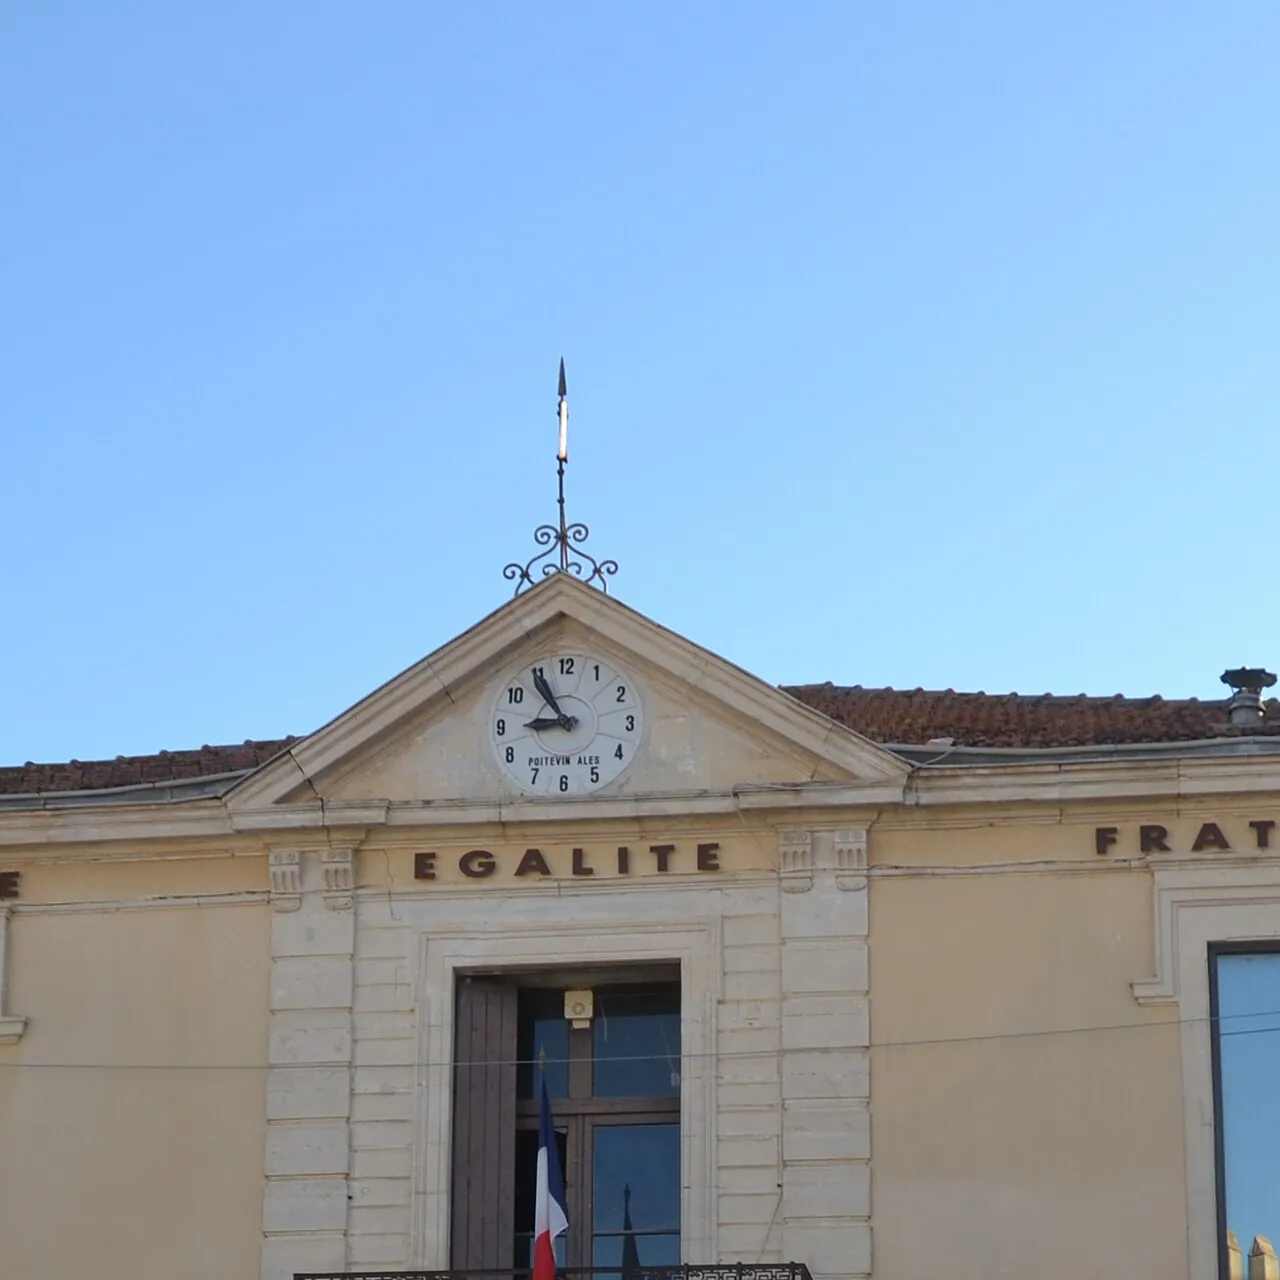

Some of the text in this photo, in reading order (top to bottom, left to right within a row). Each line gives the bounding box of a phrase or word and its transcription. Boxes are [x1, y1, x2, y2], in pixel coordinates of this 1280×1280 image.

[559, 658, 574, 675] 12
[594, 665, 600, 681] 1
[508, 687, 524, 704] 10
[616, 686, 626, 703] 2
[497, 719, 506, 736] 9
[625, 715, 635, 732] 3
[505, 746, 515, 763] 8
[614, 743, 624, 760] 4
[528, 756, 600, 766] POITEVIN ALES
[531, 768, 540, 785] 7
[590, 766, 599, 783] 5
[559, 775, 569, 792] 6
[414, 843, 720, 879] EGALITE
